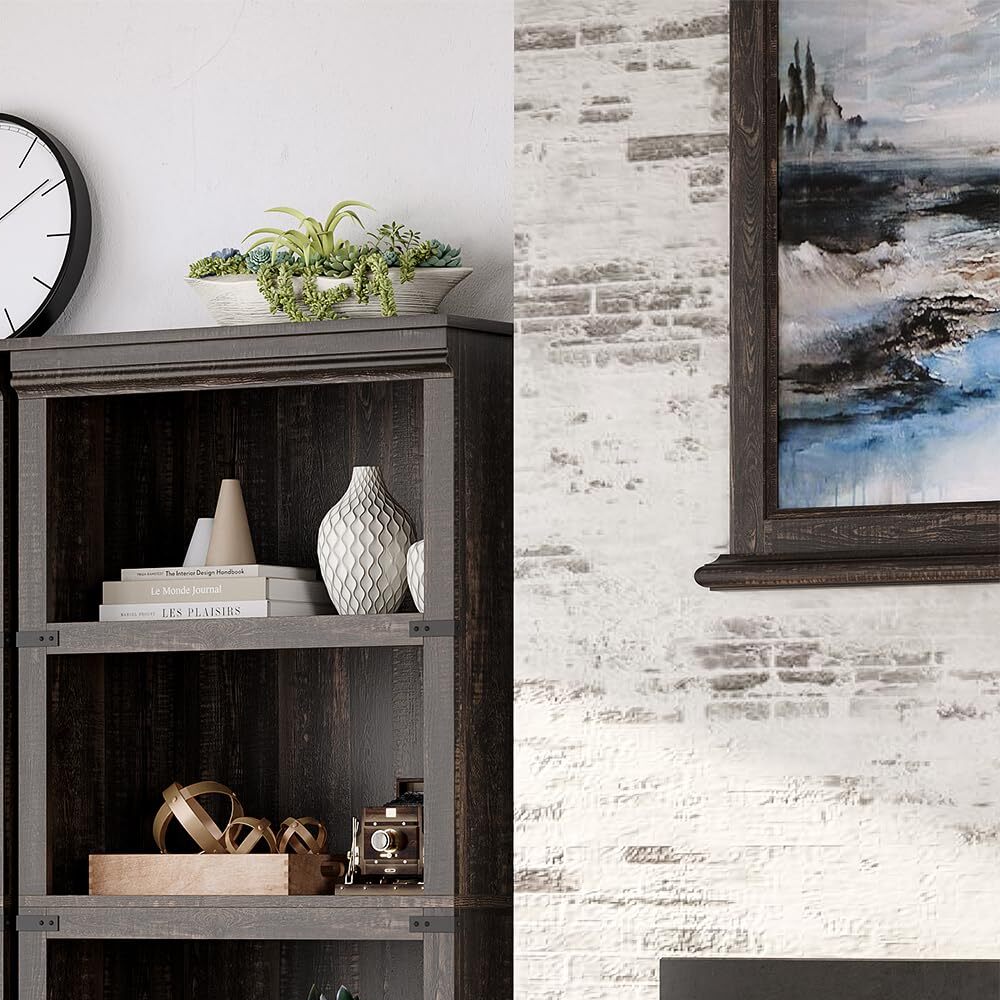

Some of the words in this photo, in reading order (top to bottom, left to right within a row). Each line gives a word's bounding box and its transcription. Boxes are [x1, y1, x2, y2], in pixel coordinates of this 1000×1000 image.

[196, 569, 215, 577] Design
[151, 587, 160, 596] Le
[162, 585, 190, 595] Monde
[192, 584, 222, 595] Journal
[162, 608, 183, 618] LES
[188, 606, 241, 617] PLAISIRS
